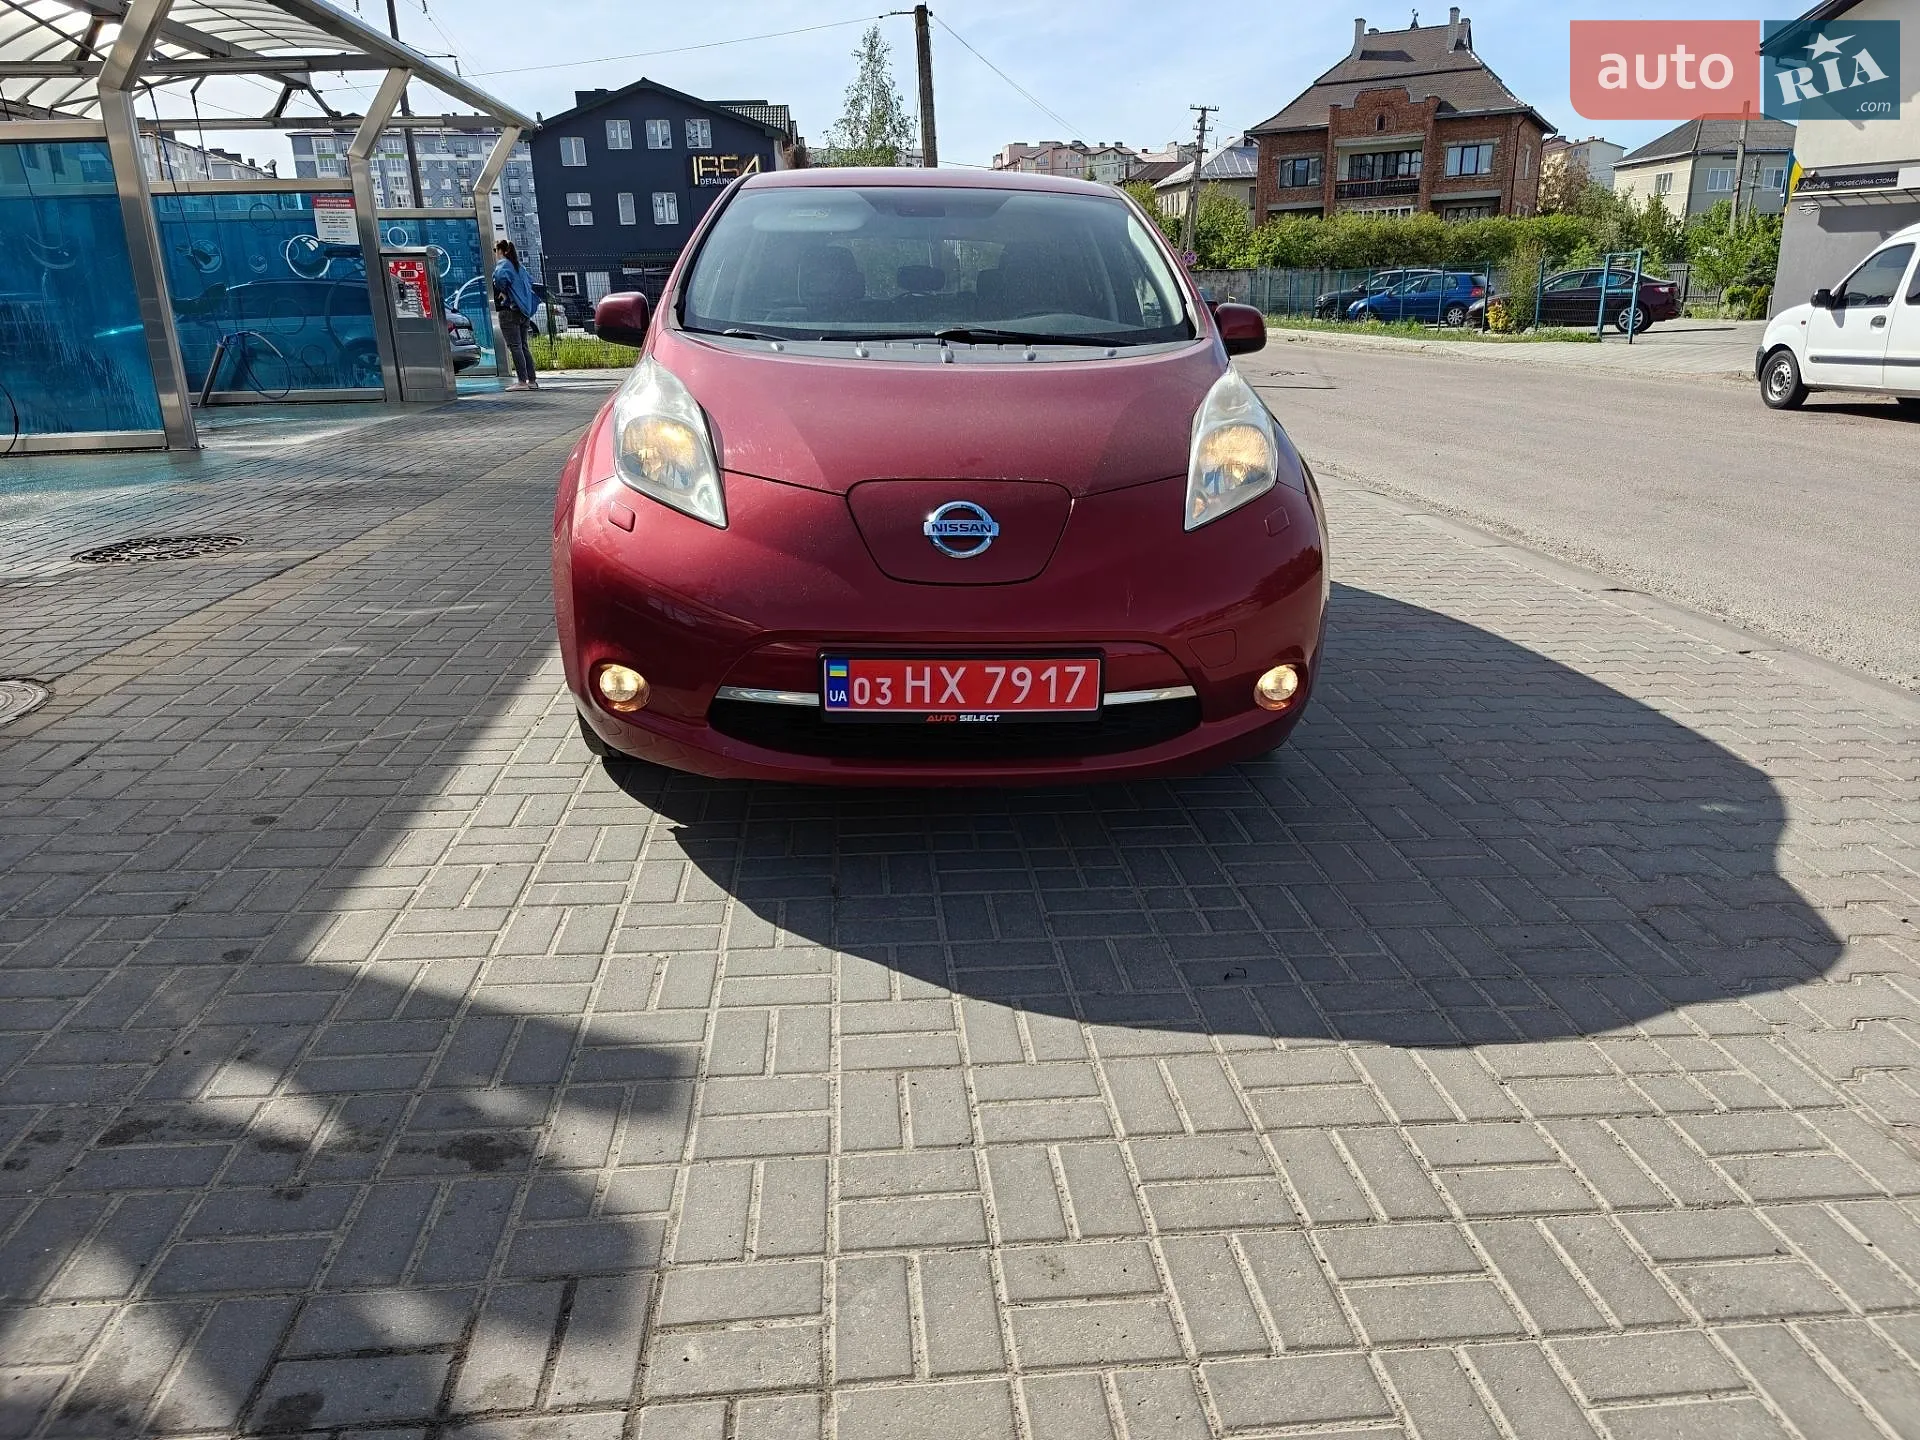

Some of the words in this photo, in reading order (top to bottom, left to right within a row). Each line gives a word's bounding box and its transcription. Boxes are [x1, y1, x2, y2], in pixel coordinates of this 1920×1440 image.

[931, 523, 992, 533] NISSAN
[853, 677, 892, 705] 03
[905, 665, 966, 704] HX
[984, 665, 1086, 704] 7917
[829, 690, 847, 702] UA
[926, 714, 957, 722] AUTO
[959, 714, 1000, 722] SELECT
